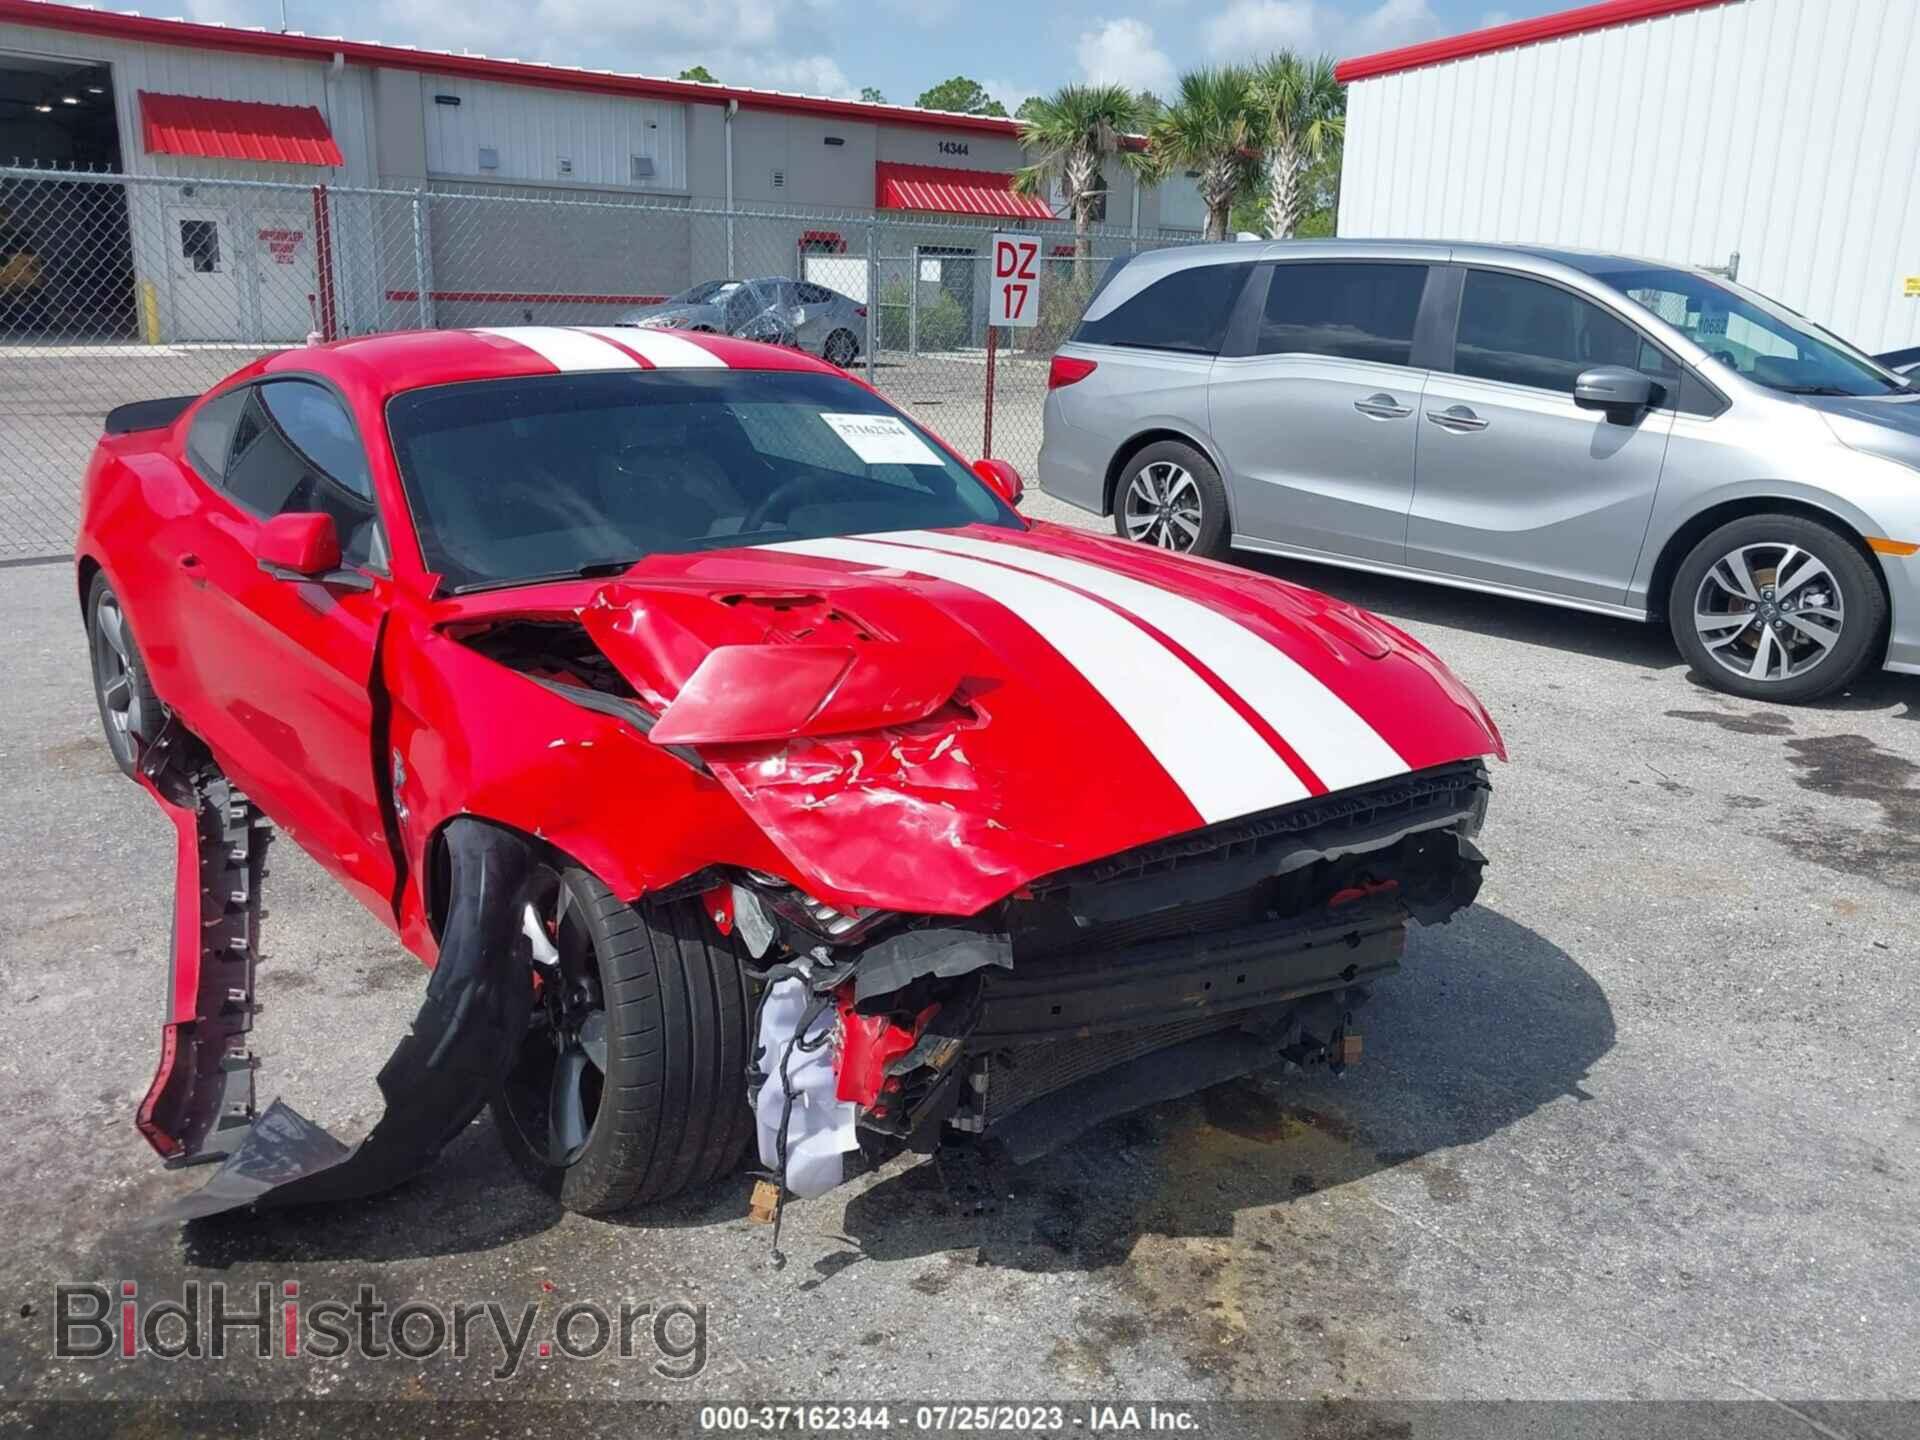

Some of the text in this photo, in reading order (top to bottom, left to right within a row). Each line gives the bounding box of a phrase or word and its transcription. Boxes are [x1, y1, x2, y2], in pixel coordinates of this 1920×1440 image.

[938, 141, 969, 156] 14344
[996, 241, 1038, 280] DZ
[1003, 283, 1028, 319] 17
